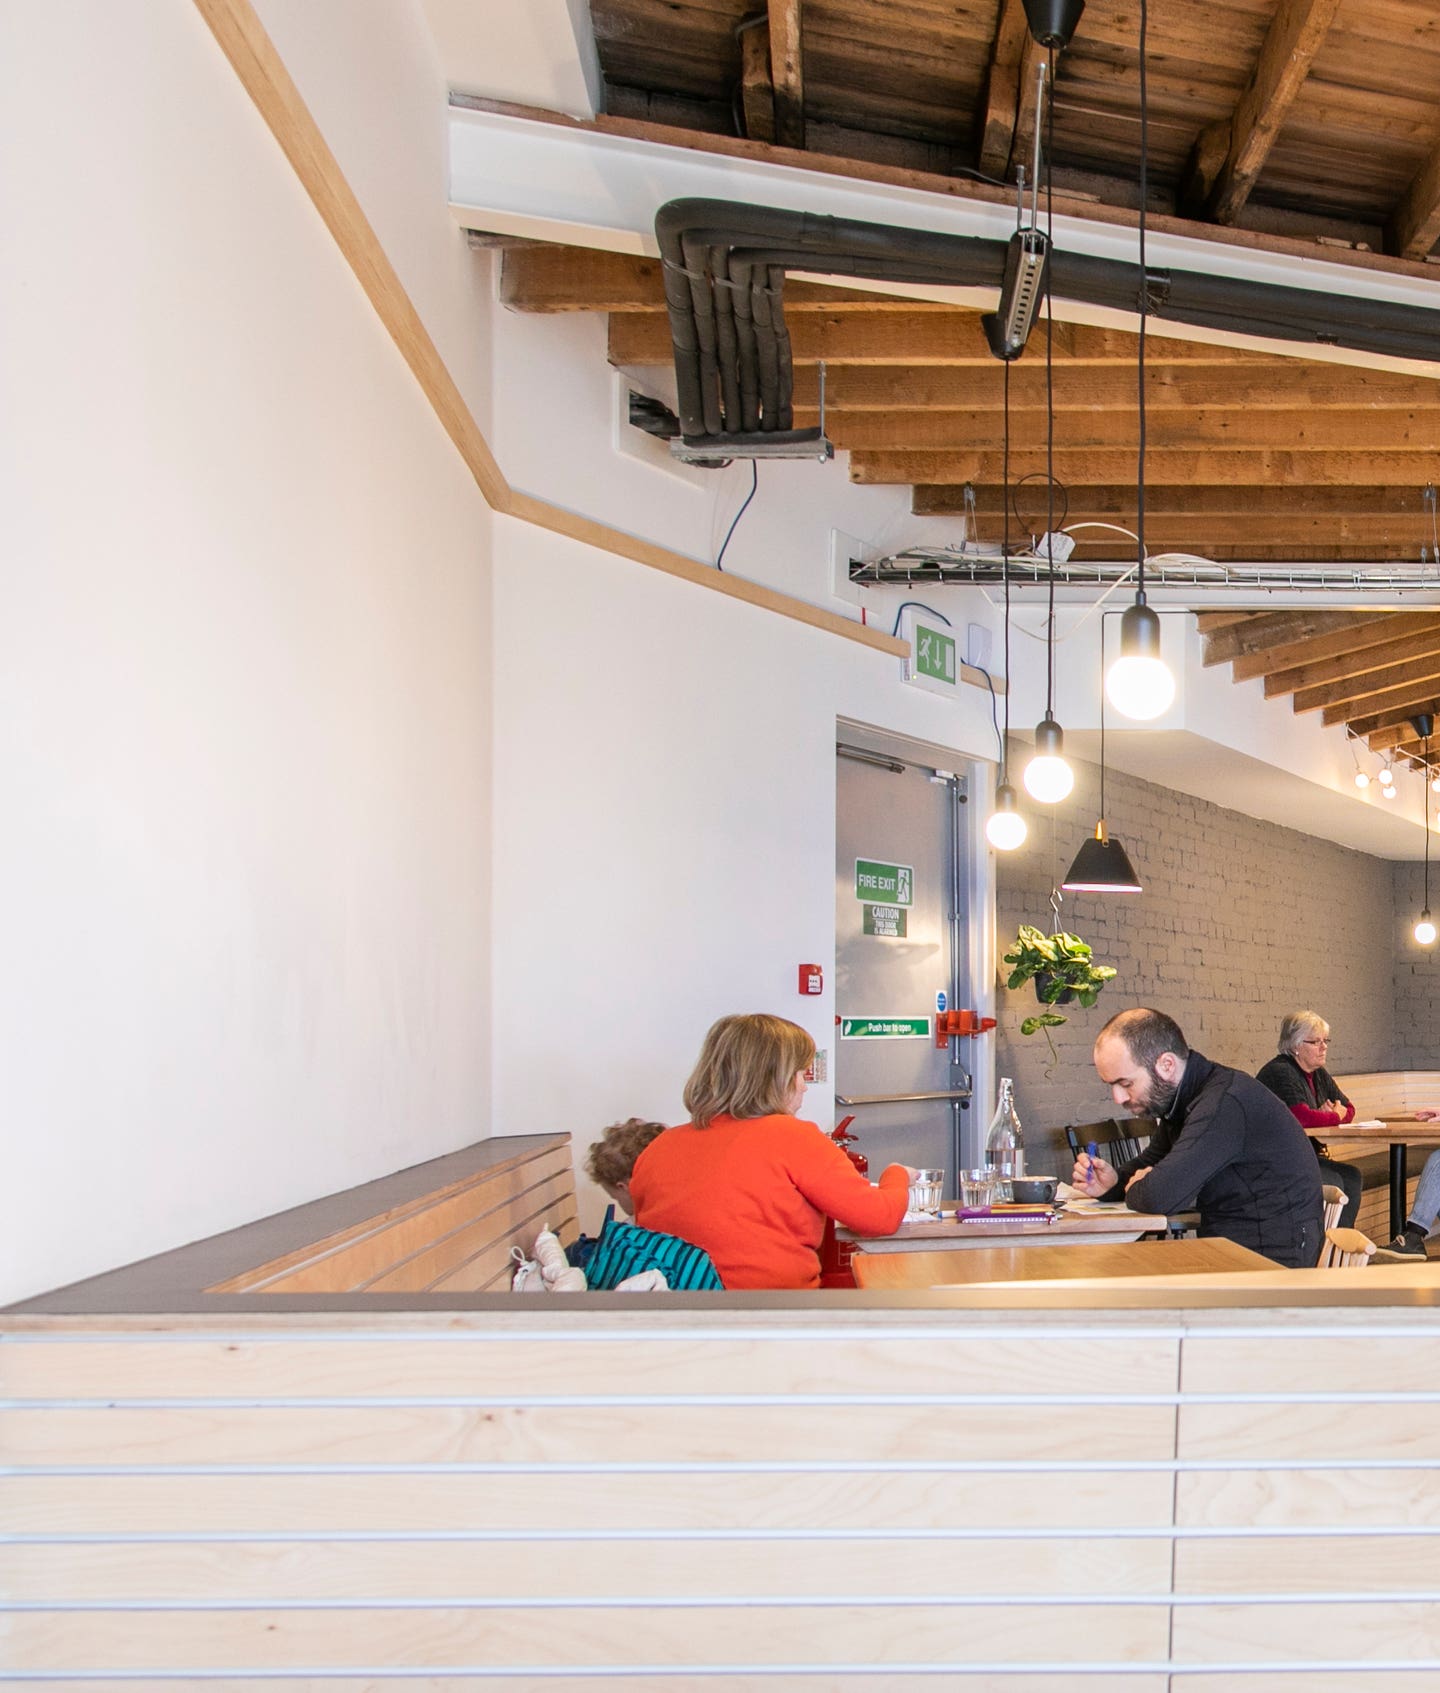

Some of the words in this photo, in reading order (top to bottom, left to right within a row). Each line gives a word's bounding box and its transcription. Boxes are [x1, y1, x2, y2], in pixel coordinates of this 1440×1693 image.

[858, 874, 877, 888] FIRE
[878, 876, 896, 890] EXIT
[872, 906, 899, 919] CAUTION
[868, 1023, 882, 1032] Push
[899, 1025, 912, 1034] open
